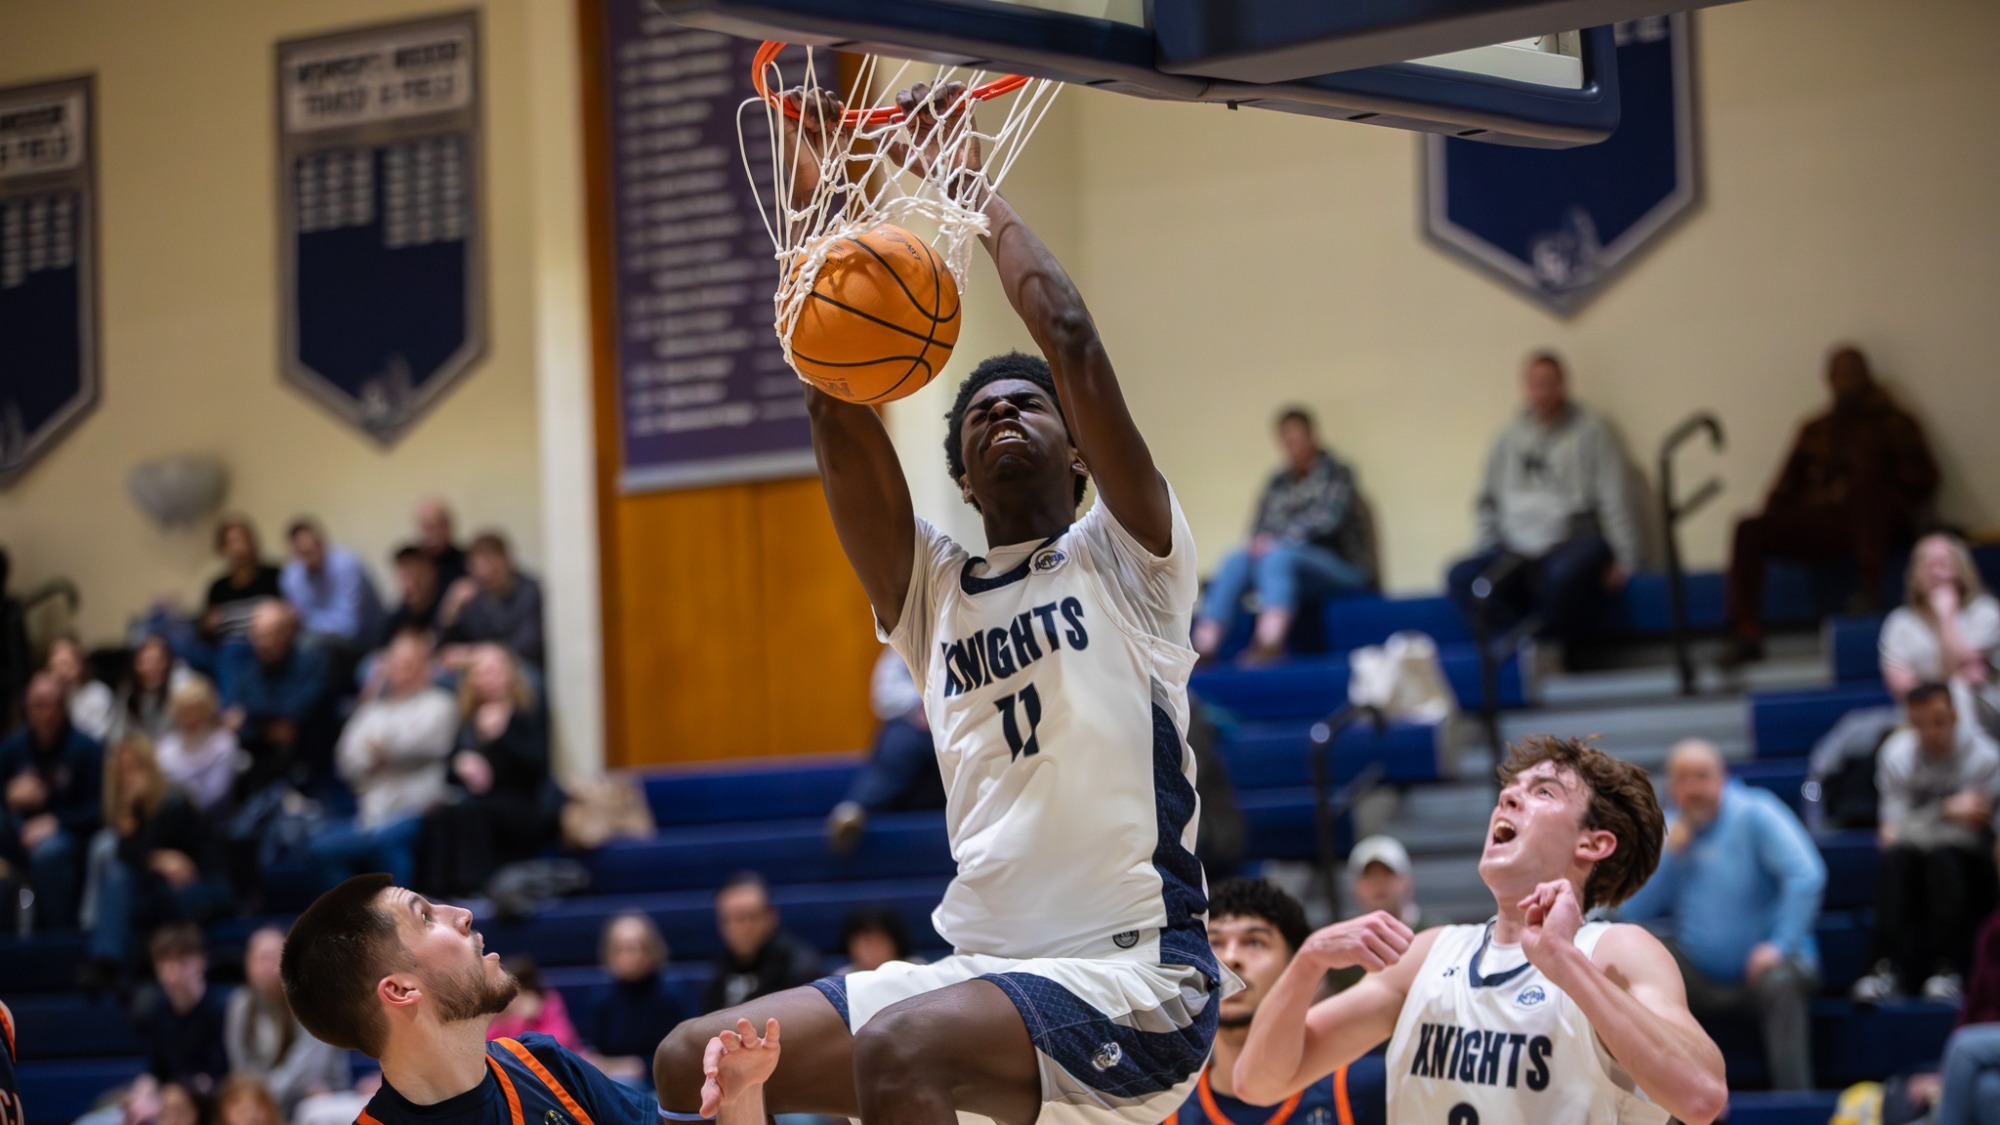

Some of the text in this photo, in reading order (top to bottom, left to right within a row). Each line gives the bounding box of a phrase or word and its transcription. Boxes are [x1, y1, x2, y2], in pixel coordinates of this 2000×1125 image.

[941, 596, 1088, 698] KNIGHTS
[993, 682, 1041, 763] 11
[1410, 1023, 1553, 1092] KNIGHTS
